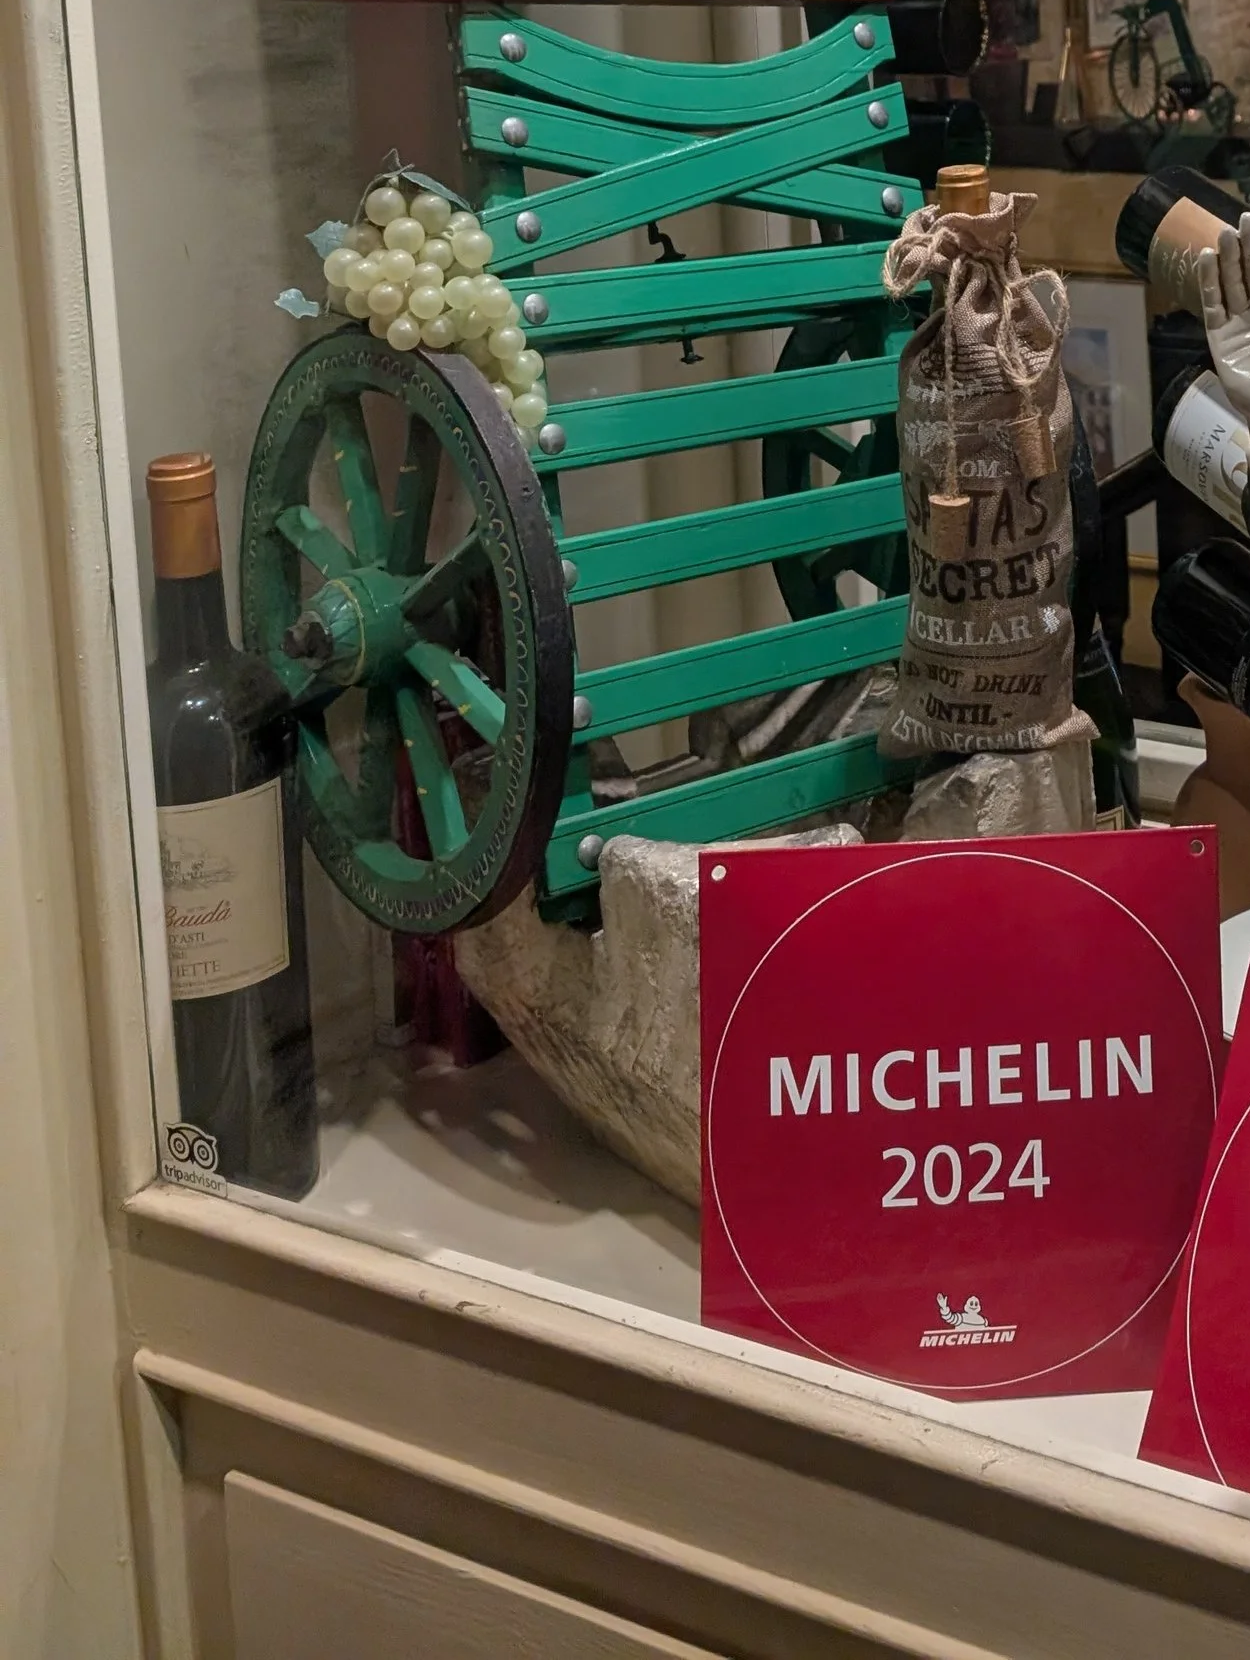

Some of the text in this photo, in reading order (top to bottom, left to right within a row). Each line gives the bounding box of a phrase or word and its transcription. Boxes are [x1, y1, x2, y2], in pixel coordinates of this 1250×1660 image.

[912, 540, 1061, 600] SECRET
[914, 611, 1033, 646] CELLAR
[924, 662, 965, 688] NOT
[972, 674, 1049, 696] DRINK
[169, 960, 221, 978] HETTE
[768, 1034, 1154, 1116] MICHELIN
[164, 1164, 225, 1192] tripadvisor
[881, 1138, 1050, 1208] 2024
[920, 1330, 1016, 1348] MICHELIN
